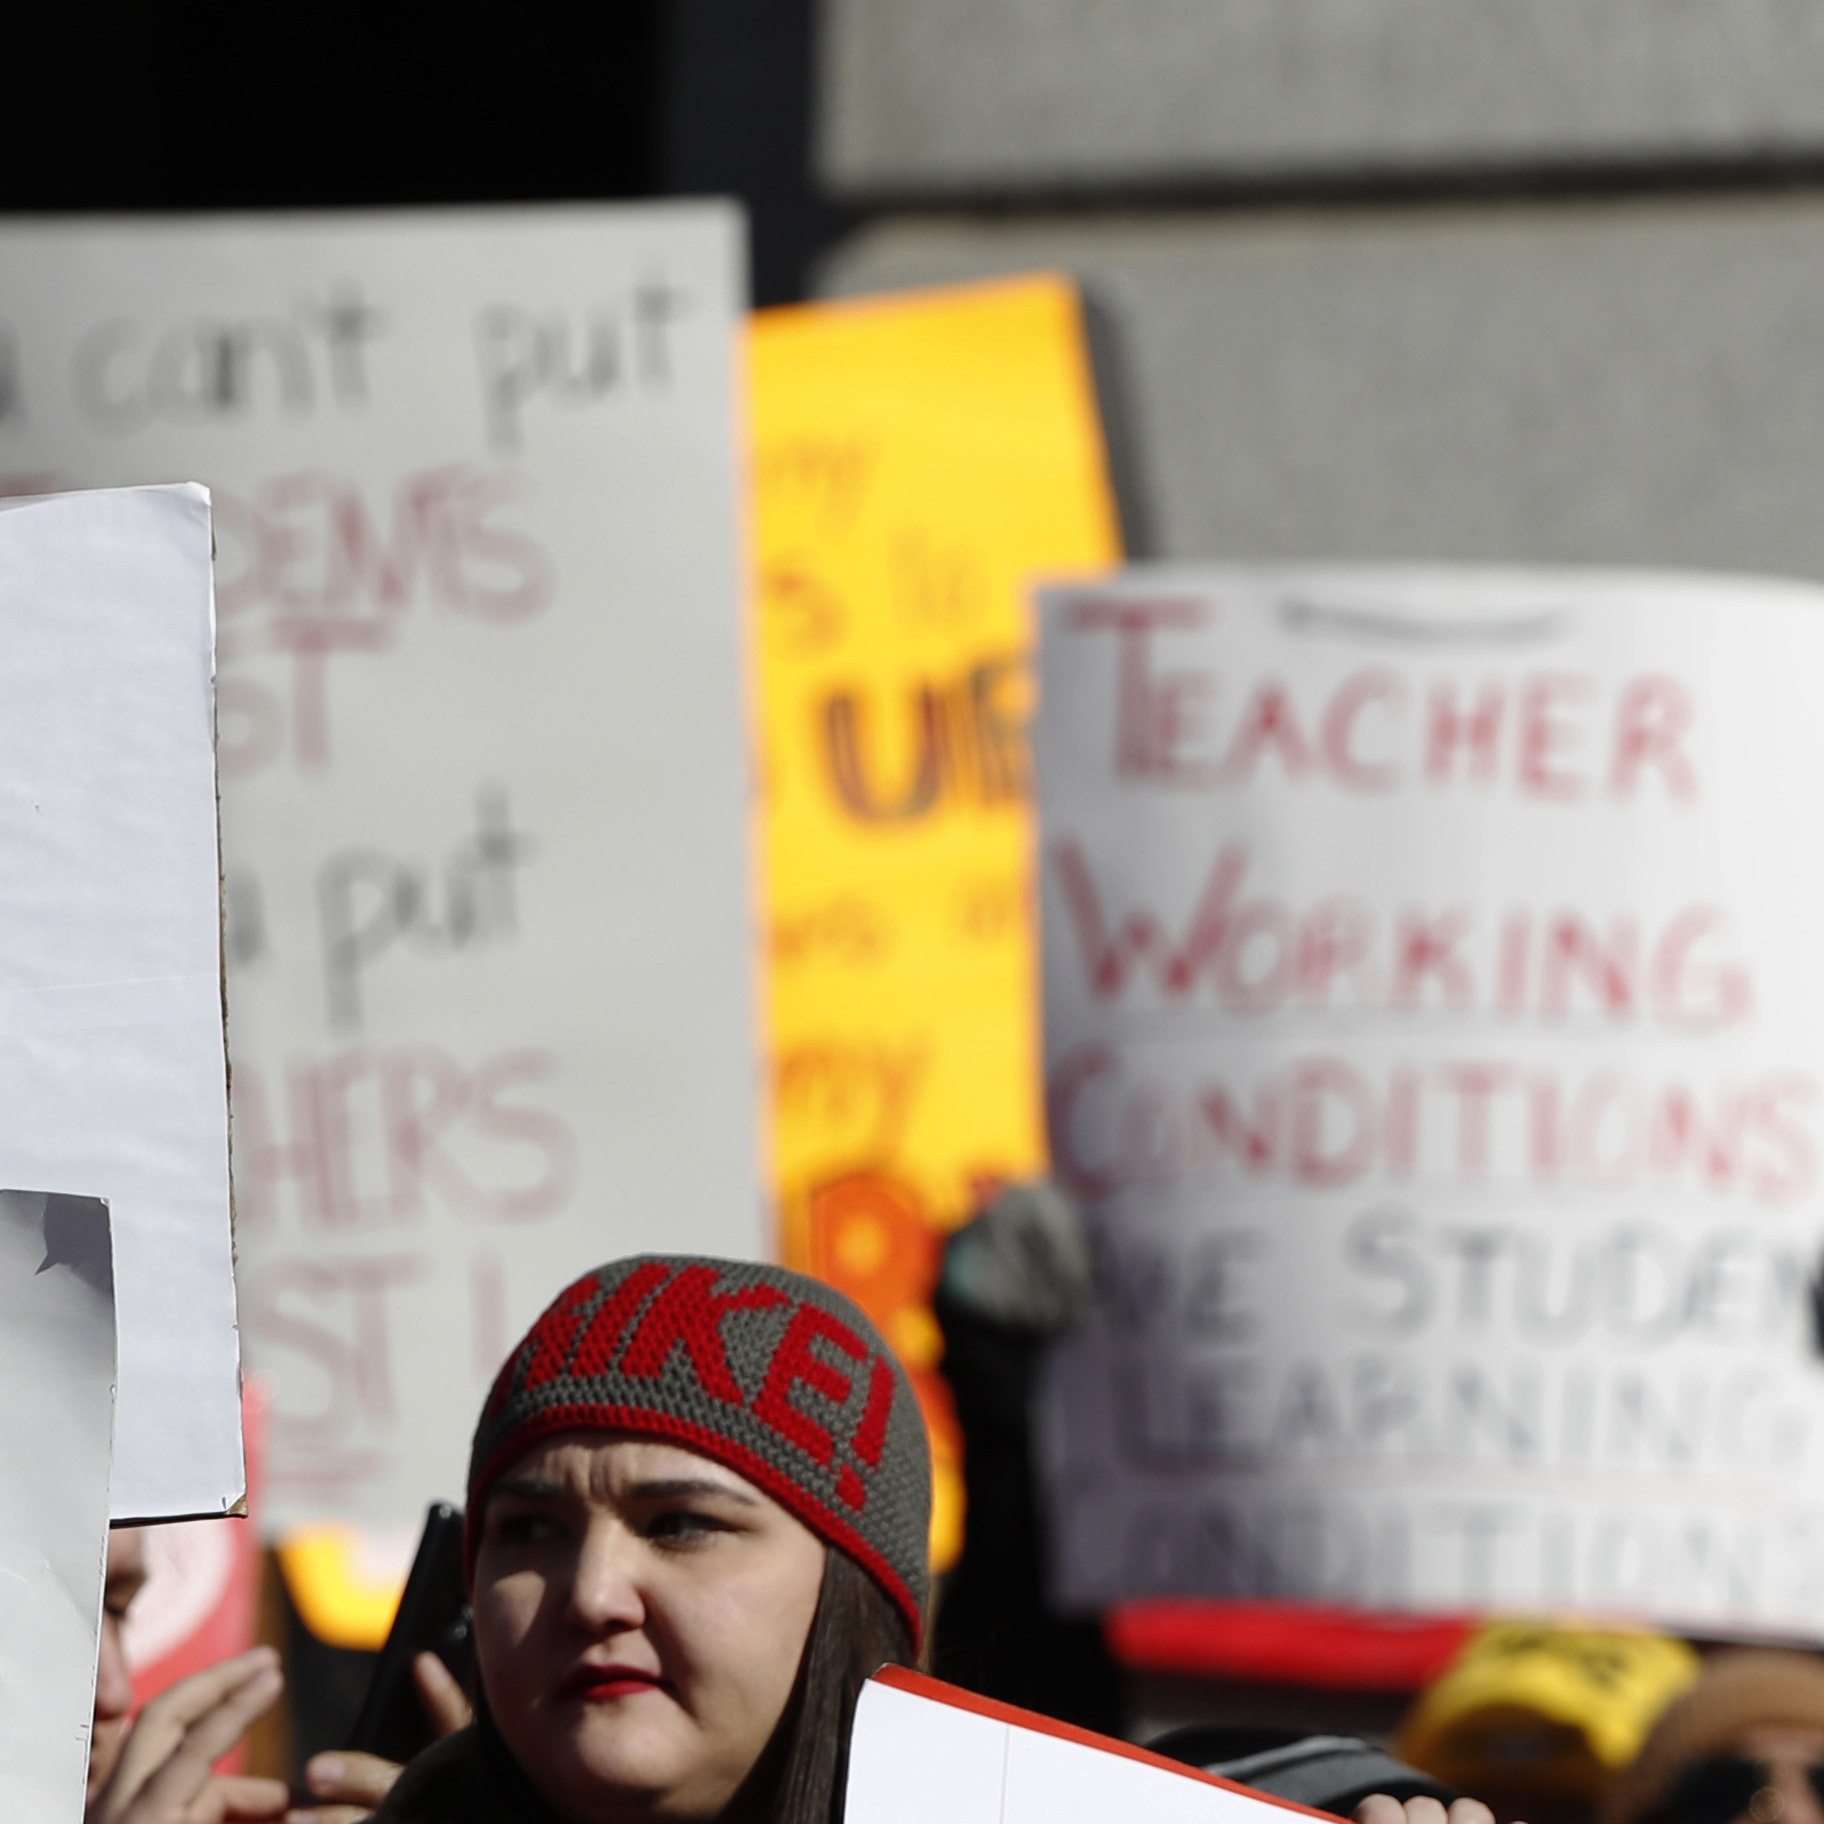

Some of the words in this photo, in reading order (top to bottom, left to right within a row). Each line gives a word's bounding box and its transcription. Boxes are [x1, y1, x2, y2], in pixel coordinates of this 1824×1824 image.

[68, 276, 394, 428] can't
[466, 257, 700, 460] put
[1060, 588, 1706, 809] TEACHER
[312, 773, 542, 1040] put
[1048, 834, 1762, 1034] WORKING
[1045, 1038, 1824, 1208] CONDITIONS
